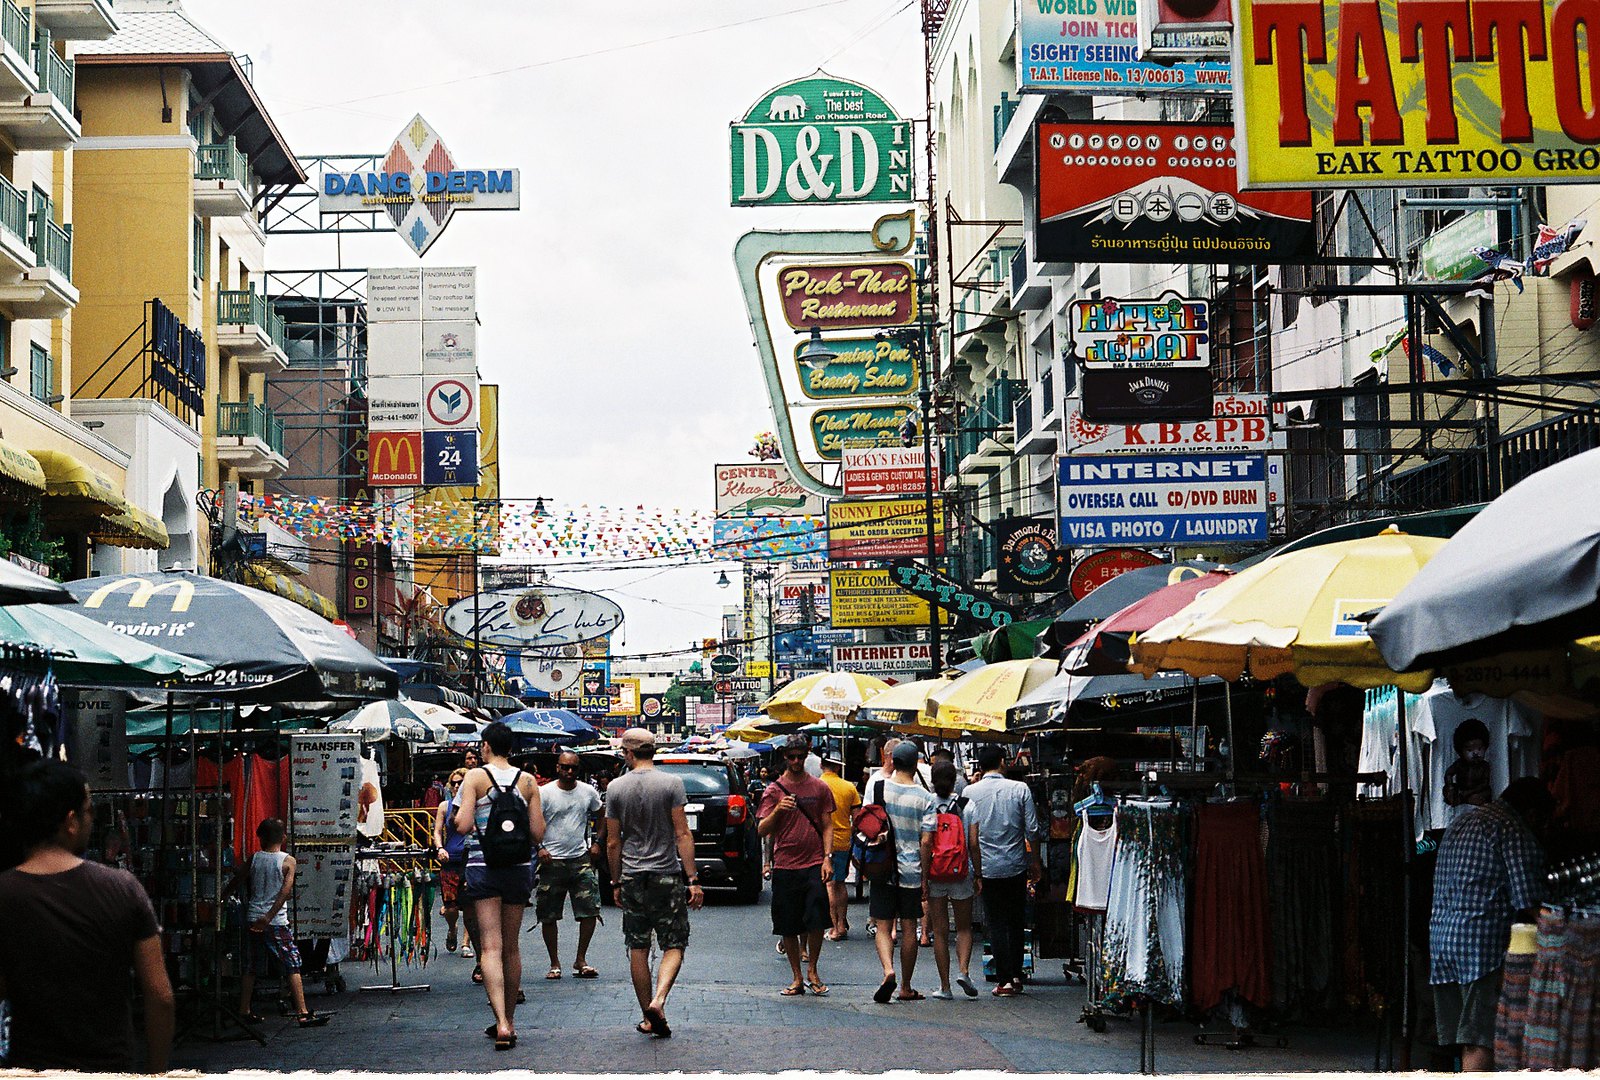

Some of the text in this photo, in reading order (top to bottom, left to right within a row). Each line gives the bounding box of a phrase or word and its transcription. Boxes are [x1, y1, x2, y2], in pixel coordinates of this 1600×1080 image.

[1038, 0, 1097, 15] WORLD
[1060, 21, 1098, 37] JOIN
[1030, 44, 1079, 61] SIGHT
[1030, 68, 1059, 81] T.A.T.
[1064, 68, 1100, 82] License
[1104, 69, 1122, 82] No.
[1126, 68, 1184, 84] 13/00613
[825, 98, 864, 111] The best
[865, 111, 887, 119] Road
[1051, 135, 1160, 148] NIPPON
[738, 125, 879, 202] D&D
[889, 125, 908, 194] INN
[1064, 155, 1156, 166] JAPANESE
[1317, 152, 1383, 175] EAK
[1392, 150, 1522, 173] TATTOO
[324, 170, 513, 196] DANG DERM
[362, 195, 414, 204] Authentic
[1116, 196, 1235, 217] 日本一番
[784, 268, 909, 297] Pick-Thai
[801, 298, 897, 321] Restaurant
[809, 366, 908, 392] Beauty Salon
[815, 414, 850, 433] Thai
[438, 450, 462, 466] 24
[845, 453, 888, 467] VICKY'S
[719, 467, 778, 481] CENTER
[846, 473, 865, 482] LADIES
[871, 472, 889, 481] GENTS
[890, 471, 913, 480] CUSTOM
[1069, 461, 1253, 480] INTERNET
[720, 480, 764, 497] Khao
[1068, 492, 1125, 509] OVERSEA
[1129, 491, 1158, 508] CALL
[1167, 490, 1218, 509] CD/DVD
[1223, 489, 1257, 505] BURN
[831, 502, 941, 519] SUNNY FASHIOS
[849, 527, 924, 537] MAIL ORDER ACCEPTED
[1069, 522, 1105, 538] VISA
[1112, 520, 1165, 538] PHOTO
[1185, 518, 1259, 536] LAUNDRY
[836, 646, 906, 661] INTERNET
[836, 662, 863, 671] OVERSEA
[213, 669, 274, 686] 24 hours
[731, 681, 760, 690] TATTOO
[581, 697, 608, 707] BAG
[1122, 695, 1145, 705] open
[1145, 689, 1163, 704] 24
[296, 741, 355, 752] TRANSFER
[295, 845, 351, 854] TRANSFER
